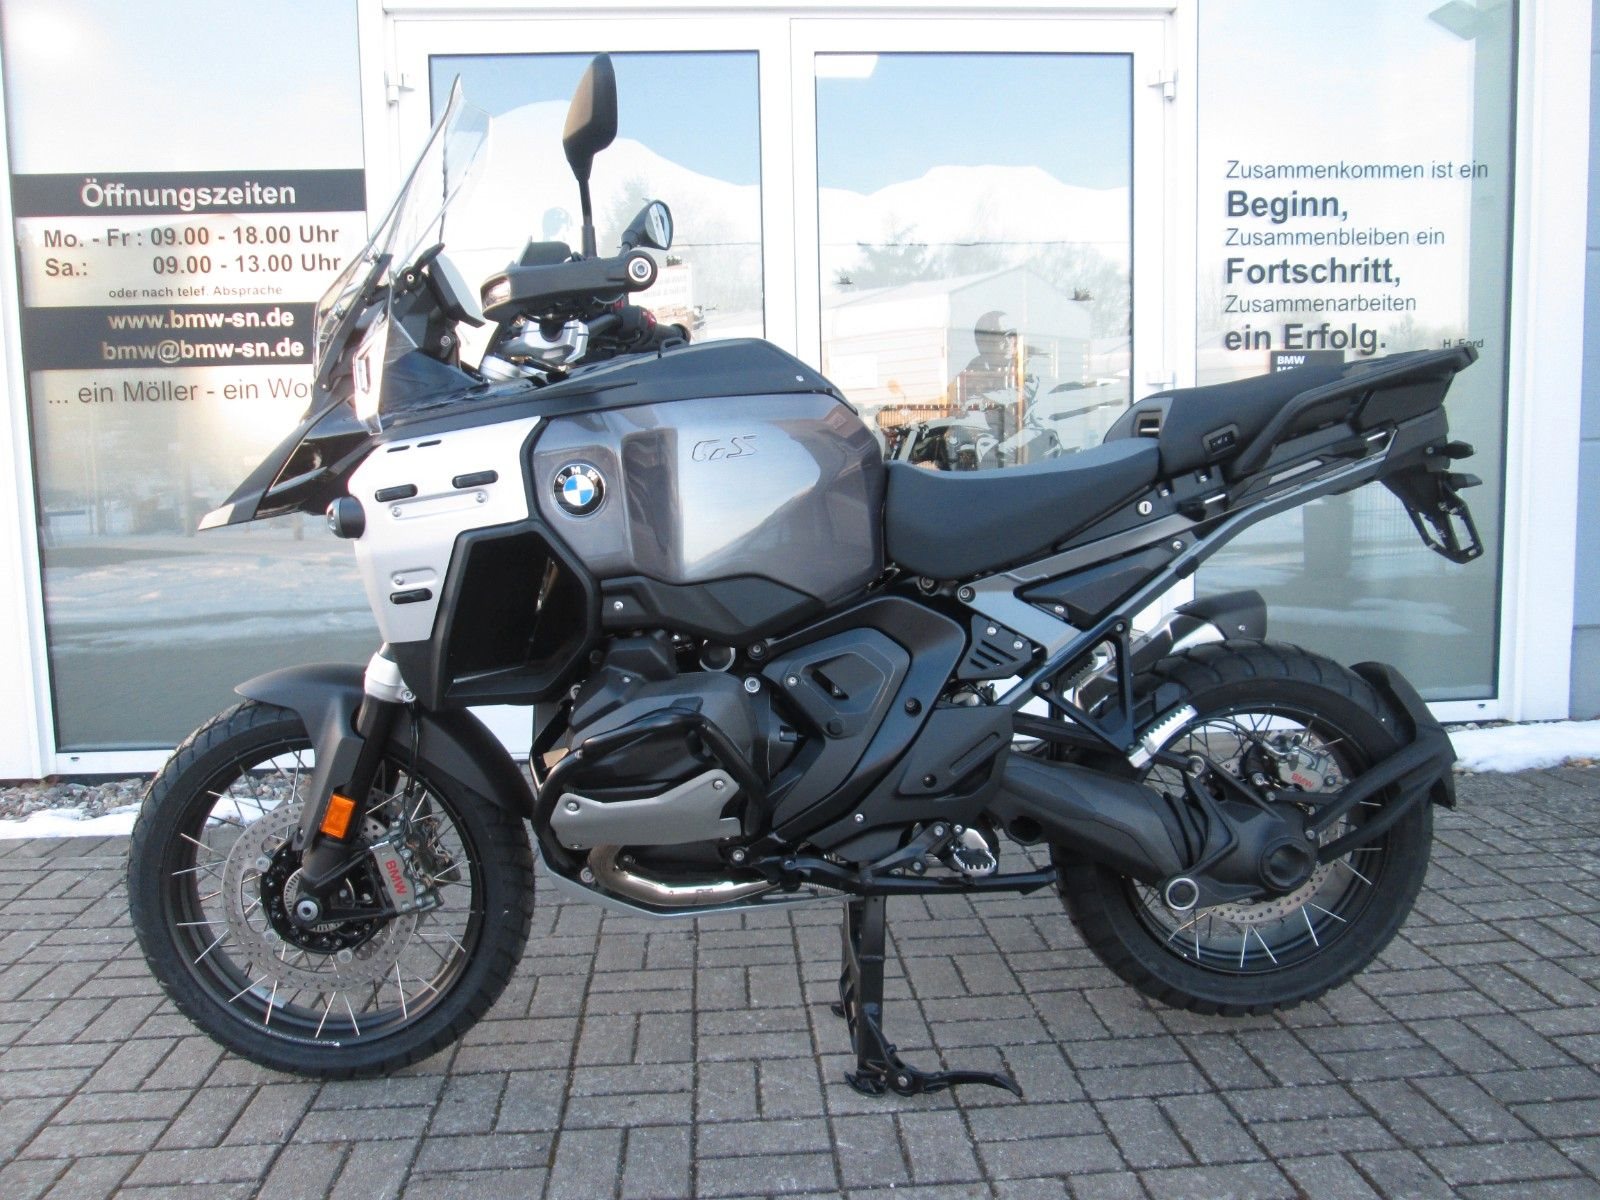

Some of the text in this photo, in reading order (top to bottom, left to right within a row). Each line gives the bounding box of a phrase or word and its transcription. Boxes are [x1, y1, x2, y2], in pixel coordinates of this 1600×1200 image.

[1225, 160, 1489, 179] Zusammenkommen ist ein
[80, 178, 296, 211] Öffnungszeiten
[1227, 189, 1349, 224] Beginn,
[43, 229, 84, 248] Mo.
[150, 226, 210, 246] 09.00
[233, 225, 291, 245] 18.00
[299, 224, 340, 243] Uhr
[1225, 227, 1445, 246] Zusammenbleiben ein
[45, 257, 88, 277] Sa.:
[153, 254, 212, 275] 09.00
[235, 253, 293, 273] 13.00
[301, 252, 342, 271] Uhr
[1226, 257, 1401, 287] Fortschritt,
[108, 287, 138, 298] oder
[142, 286, 174, 298] nach
[213, 284, 283, 298] Absprache
[1224, 294, 1417, 313] Zusammenarbeiten
[107, 308, 295, 330] www.bmw-sn.de
[102, 333, 305, 363] bmw@bmw-sn.de
[1225, 323, 1387, 356] ein Erfolg.
[1277, 355, 1305, 365] BMW
[78, 382, 114, 403] ein
[123, 380, 198, 402] Möller
[223, 378, 259, 399] ein
[691, 434, 758, 463] GS
[1291, 772, 1314, 788] BMW
[385, 859, 407, 896] BMW
